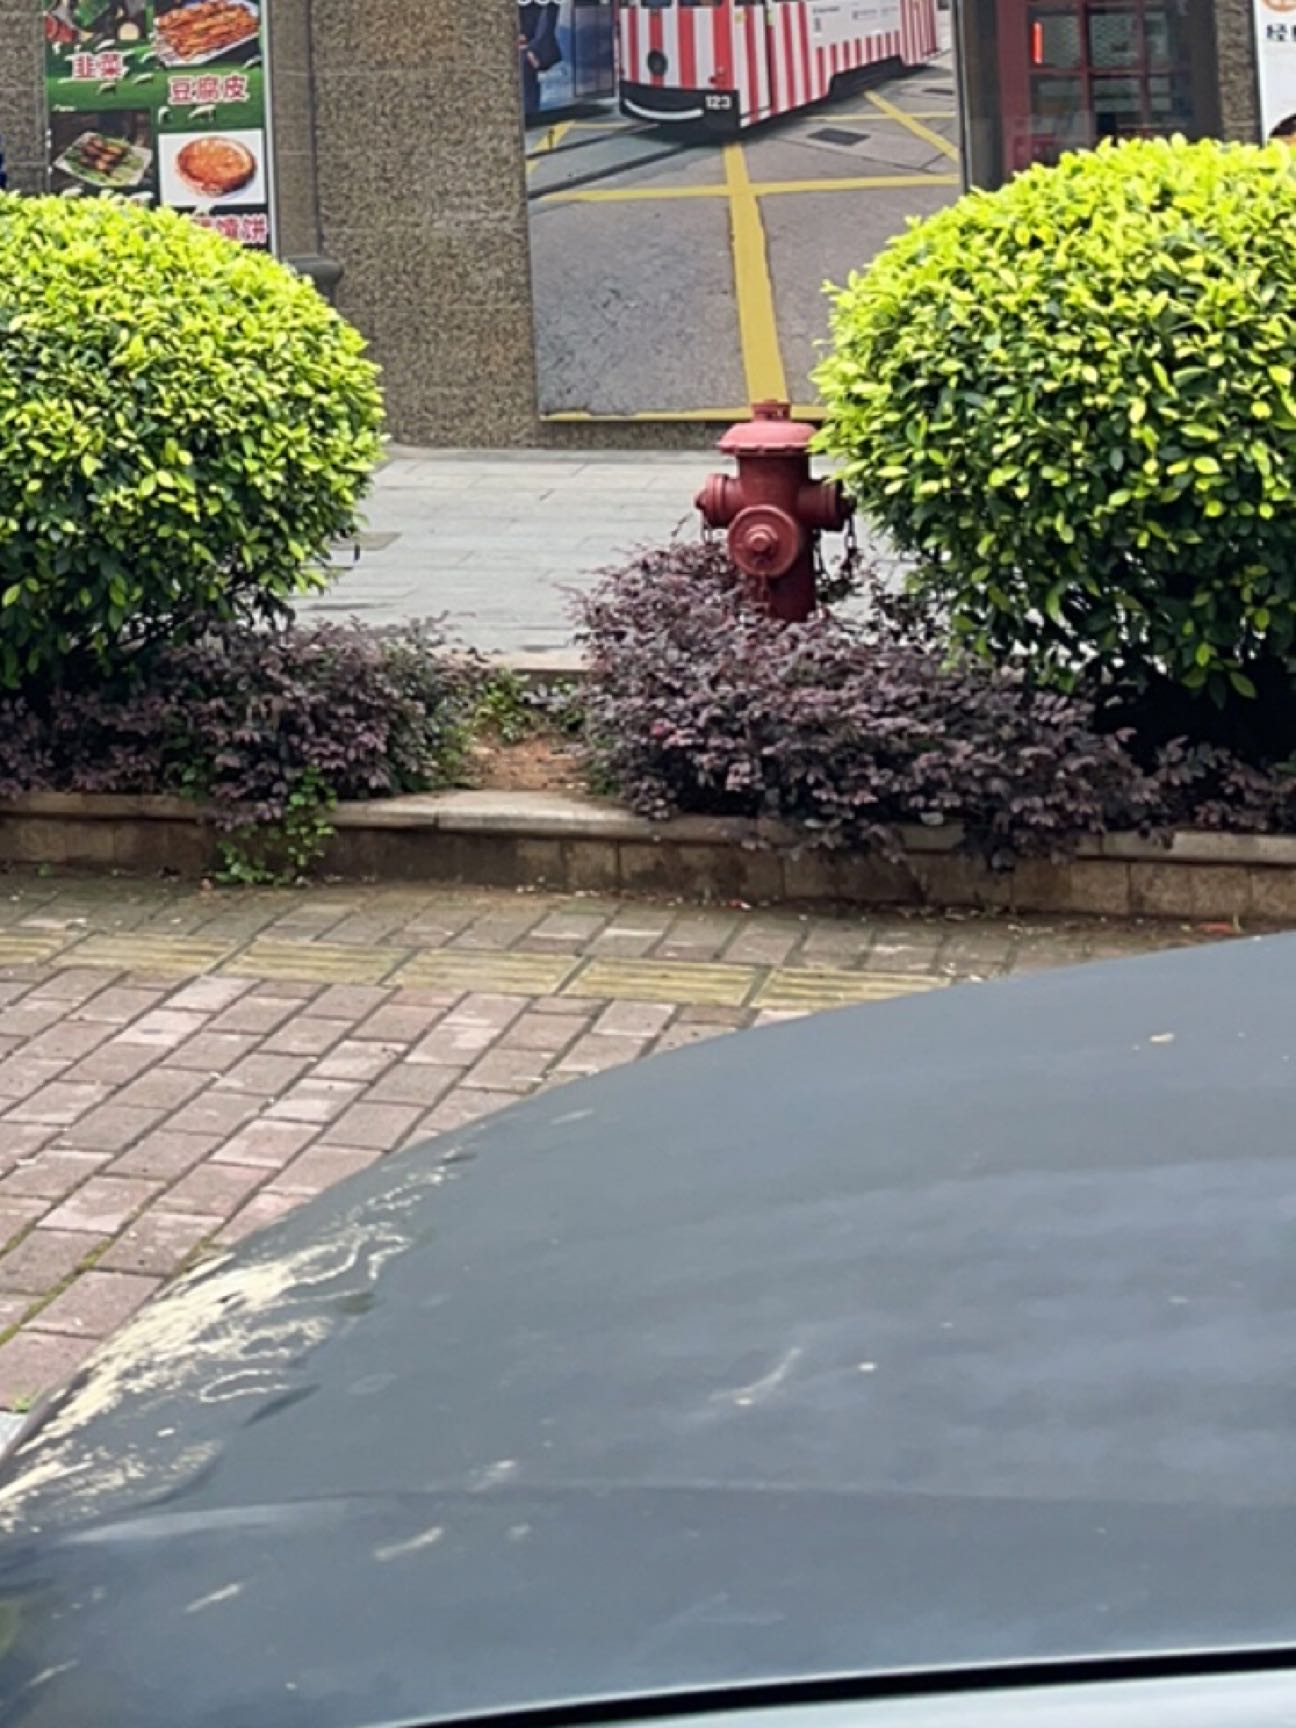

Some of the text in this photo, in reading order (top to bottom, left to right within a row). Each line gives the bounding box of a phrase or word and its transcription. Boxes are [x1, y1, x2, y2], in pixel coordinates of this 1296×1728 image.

[73, 52, 123, 78] 韭菜
[170, 76, 248, 102] 豆腐皮
